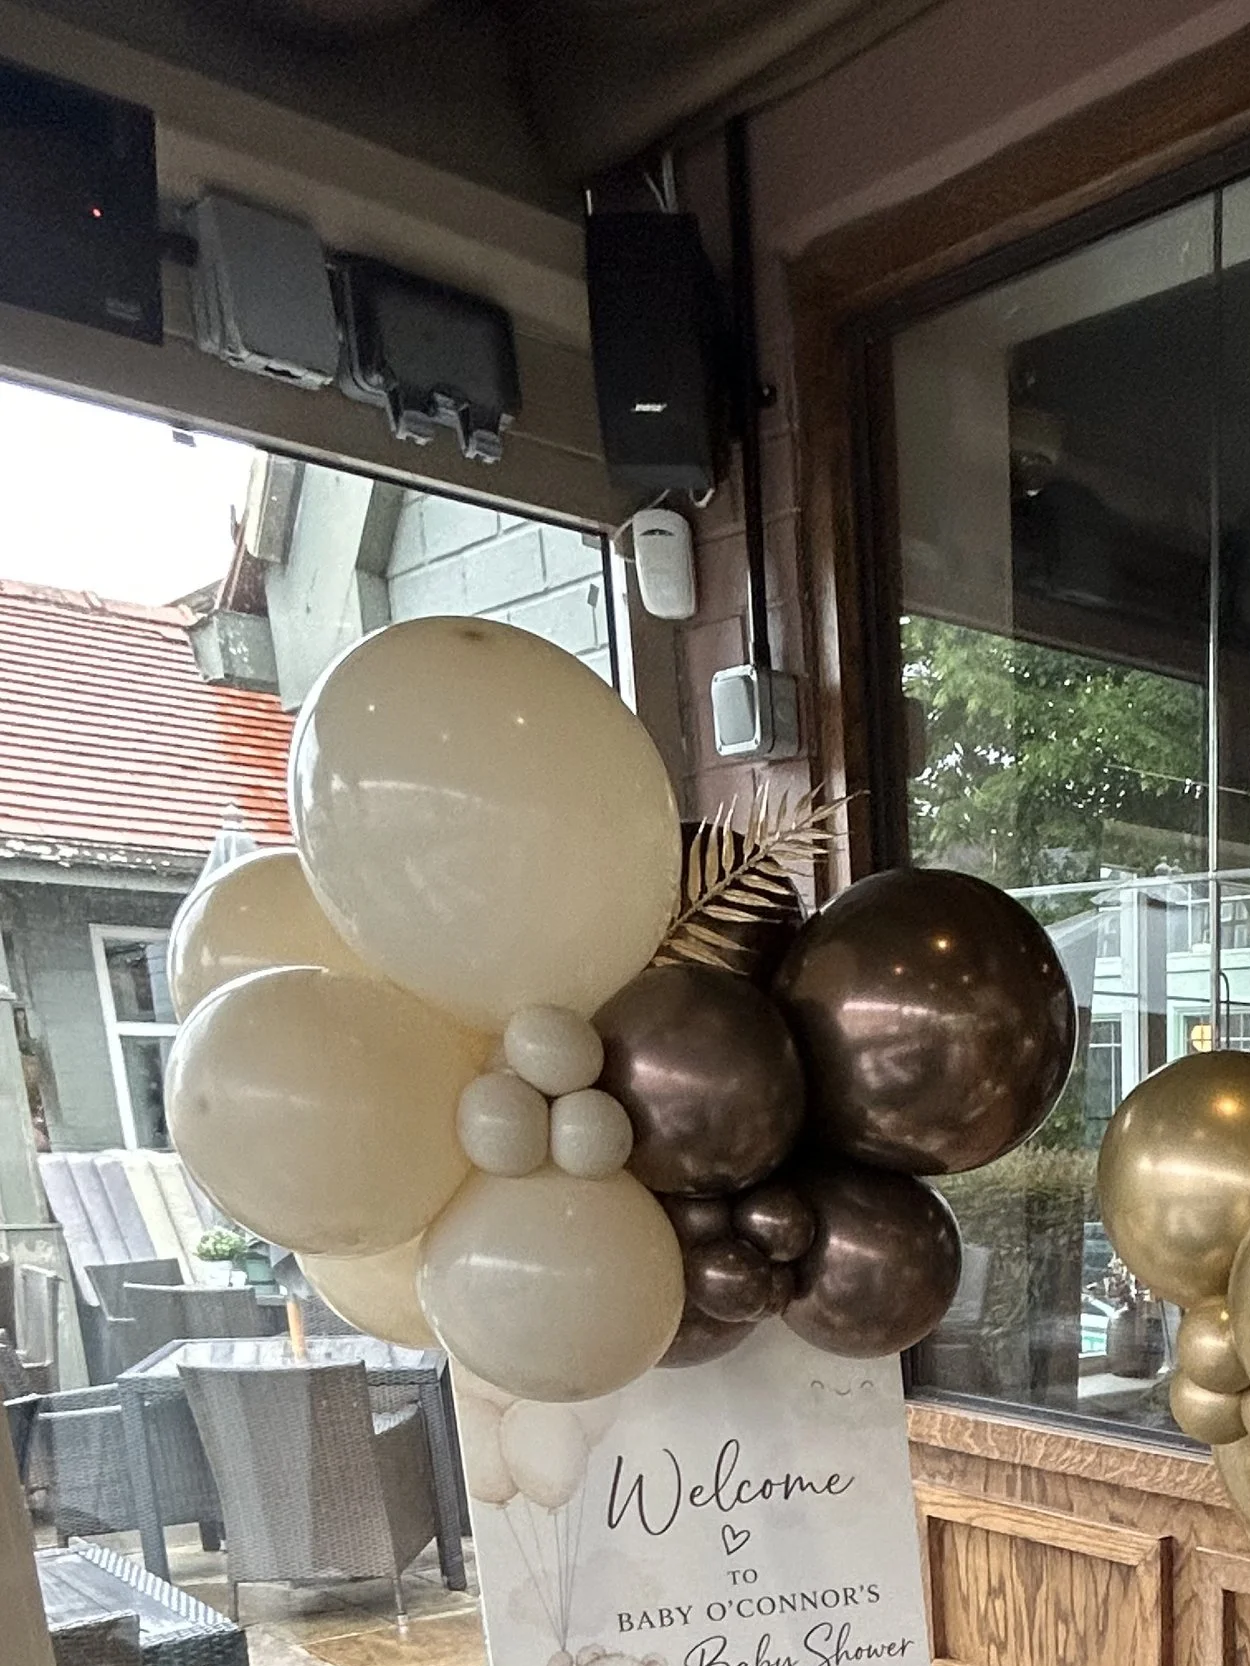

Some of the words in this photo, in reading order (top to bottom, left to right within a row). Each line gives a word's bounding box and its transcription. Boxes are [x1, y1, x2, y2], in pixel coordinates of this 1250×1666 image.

[607, 1438, 855, 1536] Welcome
[727, 1568, 759, 1586] TO
[617, 1605, 693, 1633] BABY
[706, 1584, 881, 1622] O'CONNOR'S
